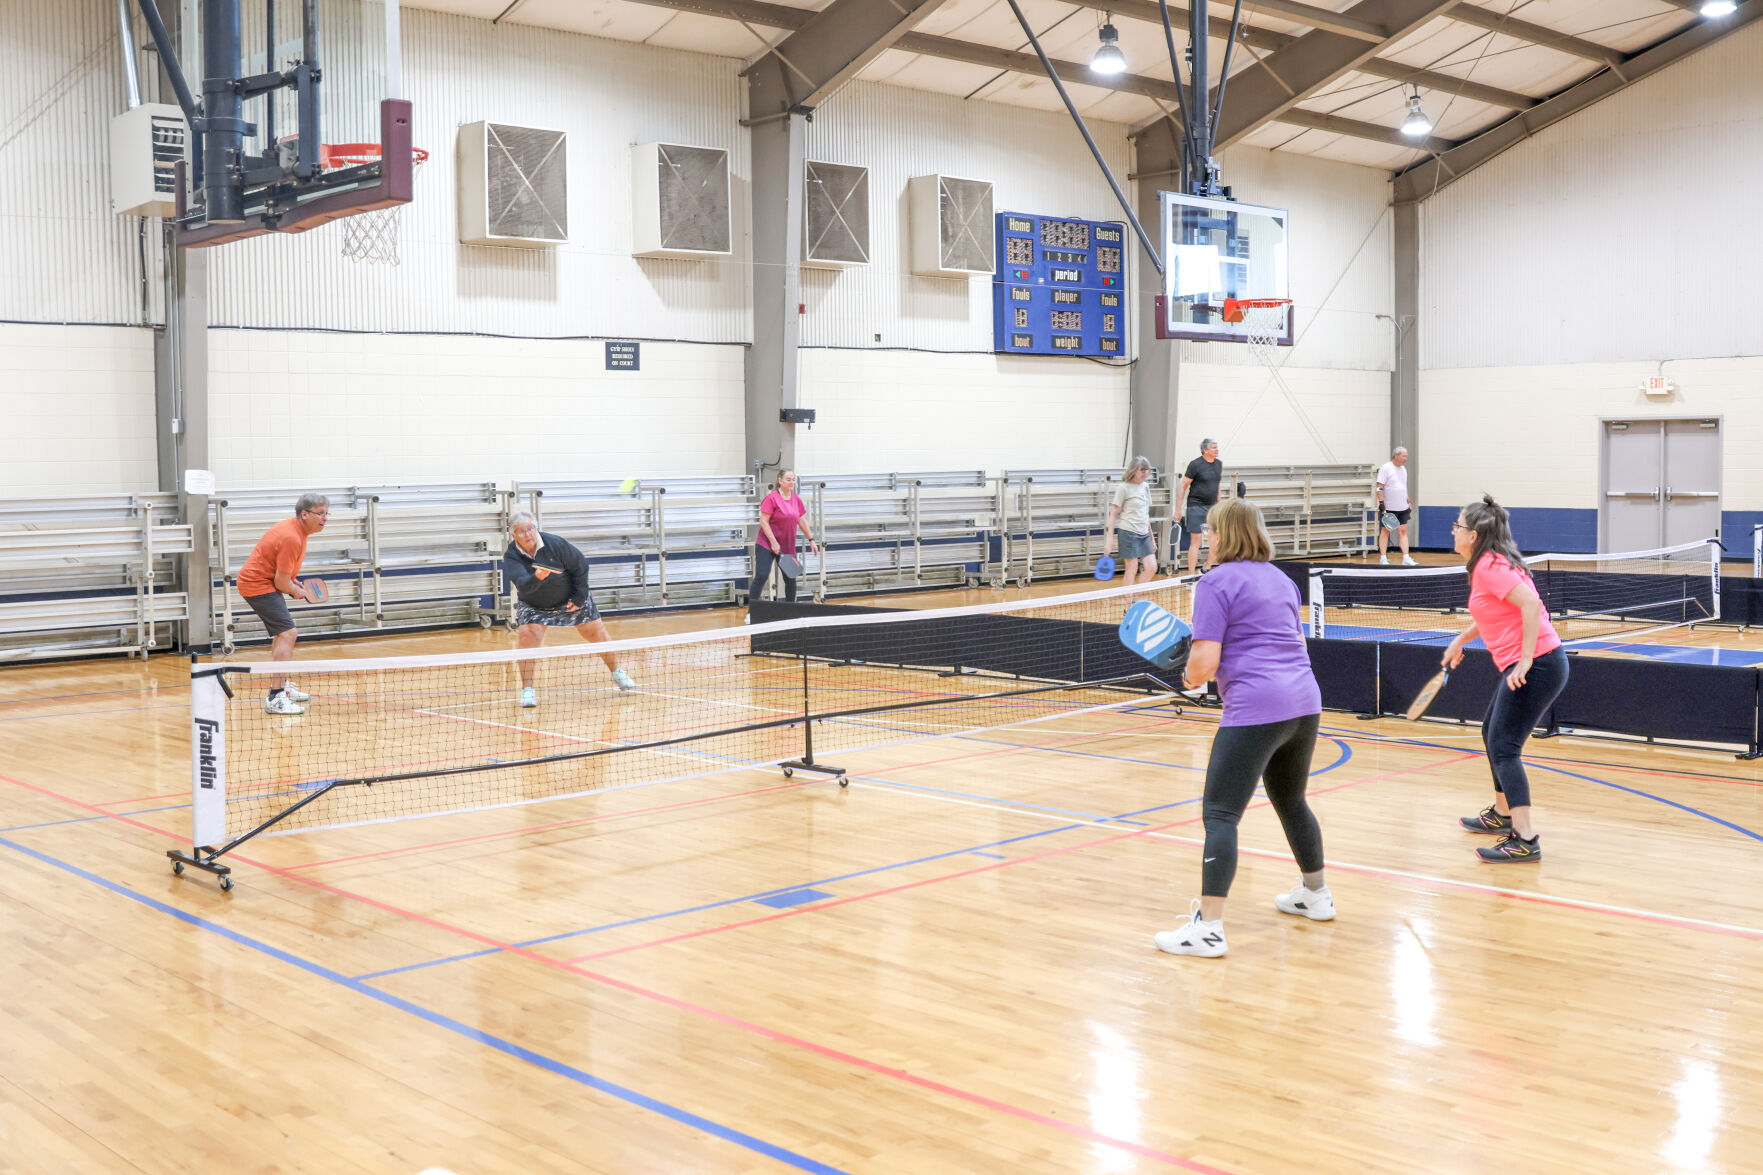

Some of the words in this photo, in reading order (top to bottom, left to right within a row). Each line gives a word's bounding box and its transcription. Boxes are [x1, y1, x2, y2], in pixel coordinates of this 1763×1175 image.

[1009, 218, 1031, 232] Home
[1096, 228, 1120, 242] Guests
[1055, 270, 1078, 281] period
[1054, 290, 1078, 304] player
[1014, 335, 1030, 347] bout
[1055, 336, 1079, 350] weight
[1102, 338, 1117, 351] bout
[1650, 377, 1665, 389] EXIT
[194, 717, 219, 789] Franklin
